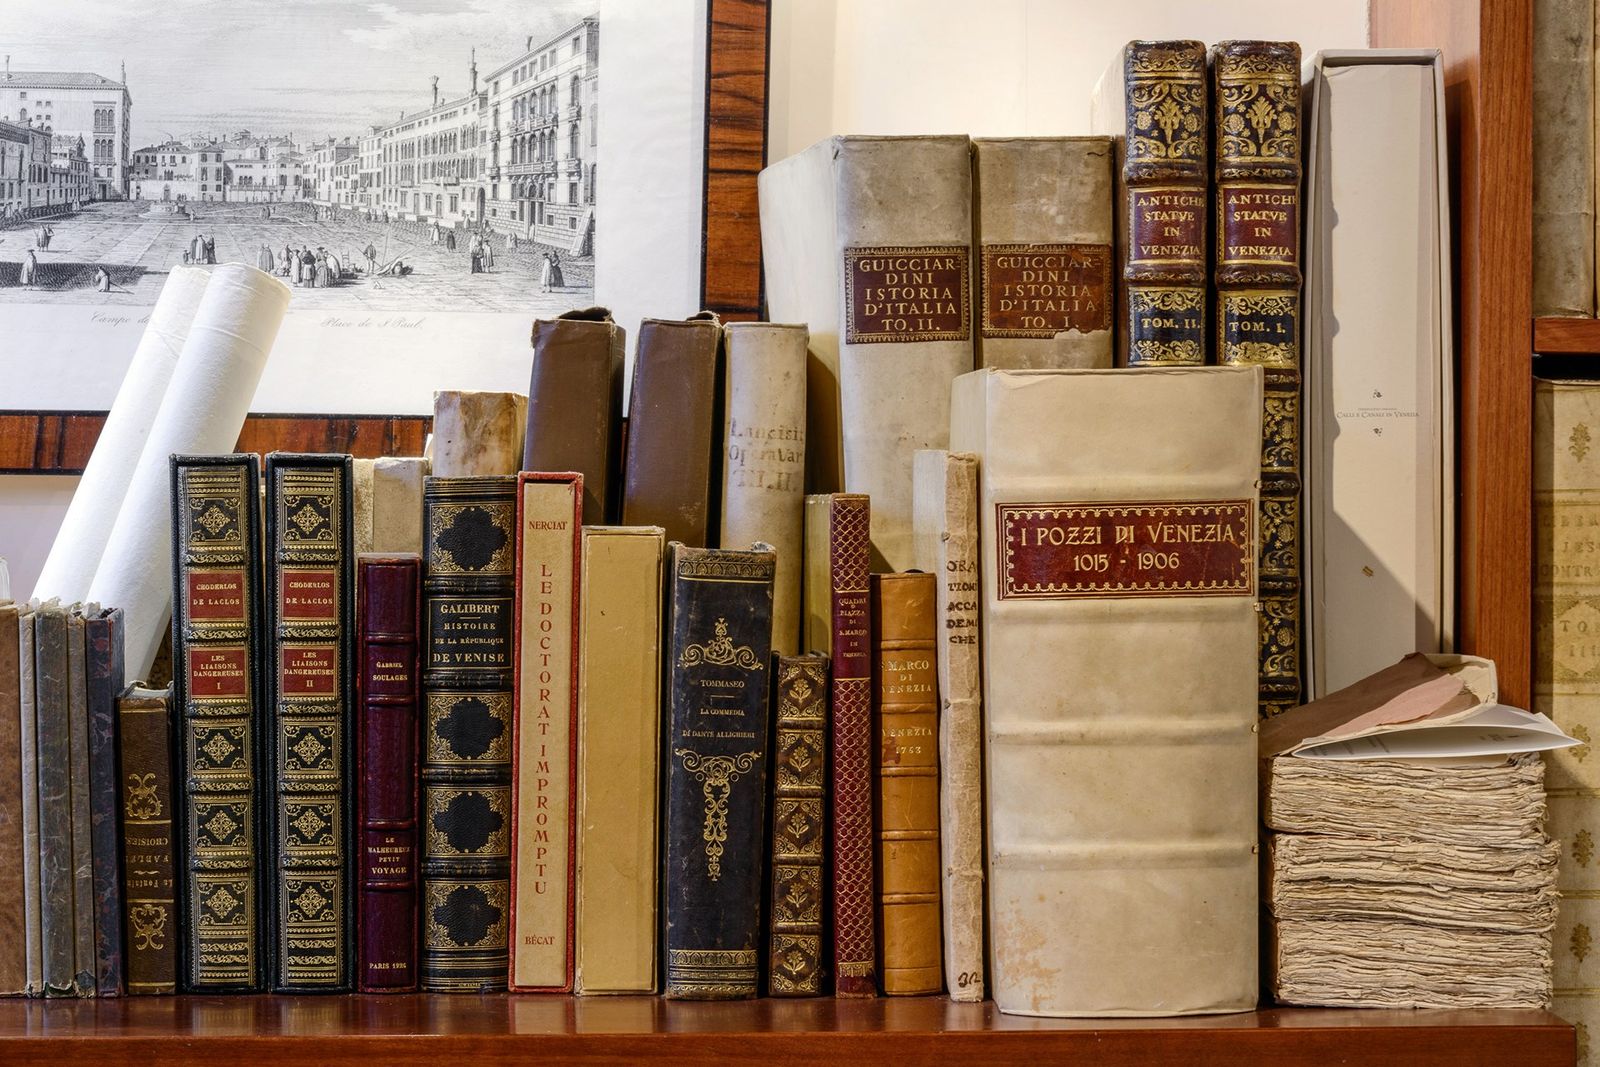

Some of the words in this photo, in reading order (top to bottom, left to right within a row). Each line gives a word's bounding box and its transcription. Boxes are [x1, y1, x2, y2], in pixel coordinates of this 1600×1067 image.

[1164, 227, 1180, 237] IN
[1255, 227, 1271, 237] IN
[1141, 245, 1201, 256] VENEZIA
[1229, 246, 1293, 256] VENEZIA
[885, 273, 934, 285] DINI
[1022, 270, 1070, 283] DINI
[865, 287, 953, 301] ISTORIA
[1004, 284, 1092, 297] ISTORIA
[881, 318, 914, 332] TO.
[1020, 316, 1053, 329] TO.
[1141, 318, 1179, 329] TOM.
[1229, 321, 1270, 333] TOM.
[529, 520, 567, 530] NERCIAT
[1020, 528, 1027, 546] I
[1037, 527, 1102, 546] POZZI
[1115, 525, 1135, 544] DI
[1147, 522, 1235, 544] VENEZIA
[946, 560, 976, 572] ORA
[1073, 554, 1109, 572] 1015
[1137, 552, 1180, 570] 1906
[441, 604, 500, 614] GALIBERT
[946, 602, 977, 611] ACCA
[949, 636, 976, 645] CHE
[433, 653, 450, 663] DE
[455, 653, 505, 663] VENISE
[537, 602, 552, 736] DOCTORAT
[900, 673, 913, 681] DI
[700, 680, 745, 688] TOMMASEO
[534, 744, 550, 894] IMPROMPTU
[371, 866, 408, 874] VOYAGE
[525, 934, 555, 945] BÉCAT
